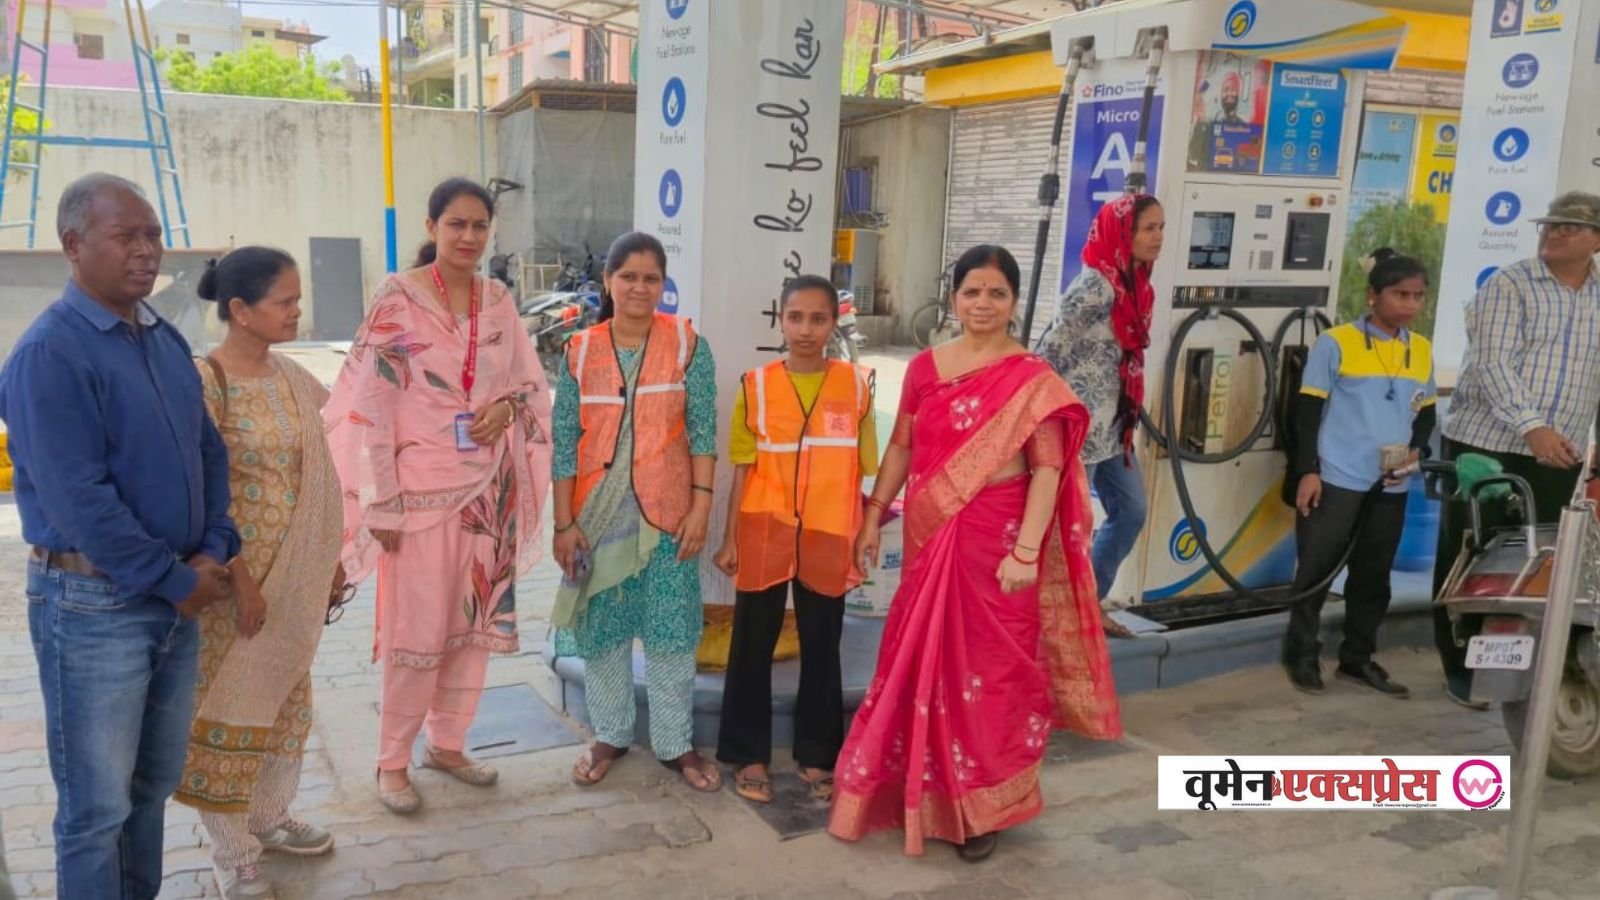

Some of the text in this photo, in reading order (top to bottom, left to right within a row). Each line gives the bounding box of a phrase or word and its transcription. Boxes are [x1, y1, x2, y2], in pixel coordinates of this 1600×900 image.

[760, 18, 820, 79] kar
[1094, 83, 1124, 97] Fino
[756, 98, 823, 172] feel
[1096, 109, 1141, 124] Micro
[754, 189, 813, 233] ko
[1205, 353, 1232, 440] Petrol
